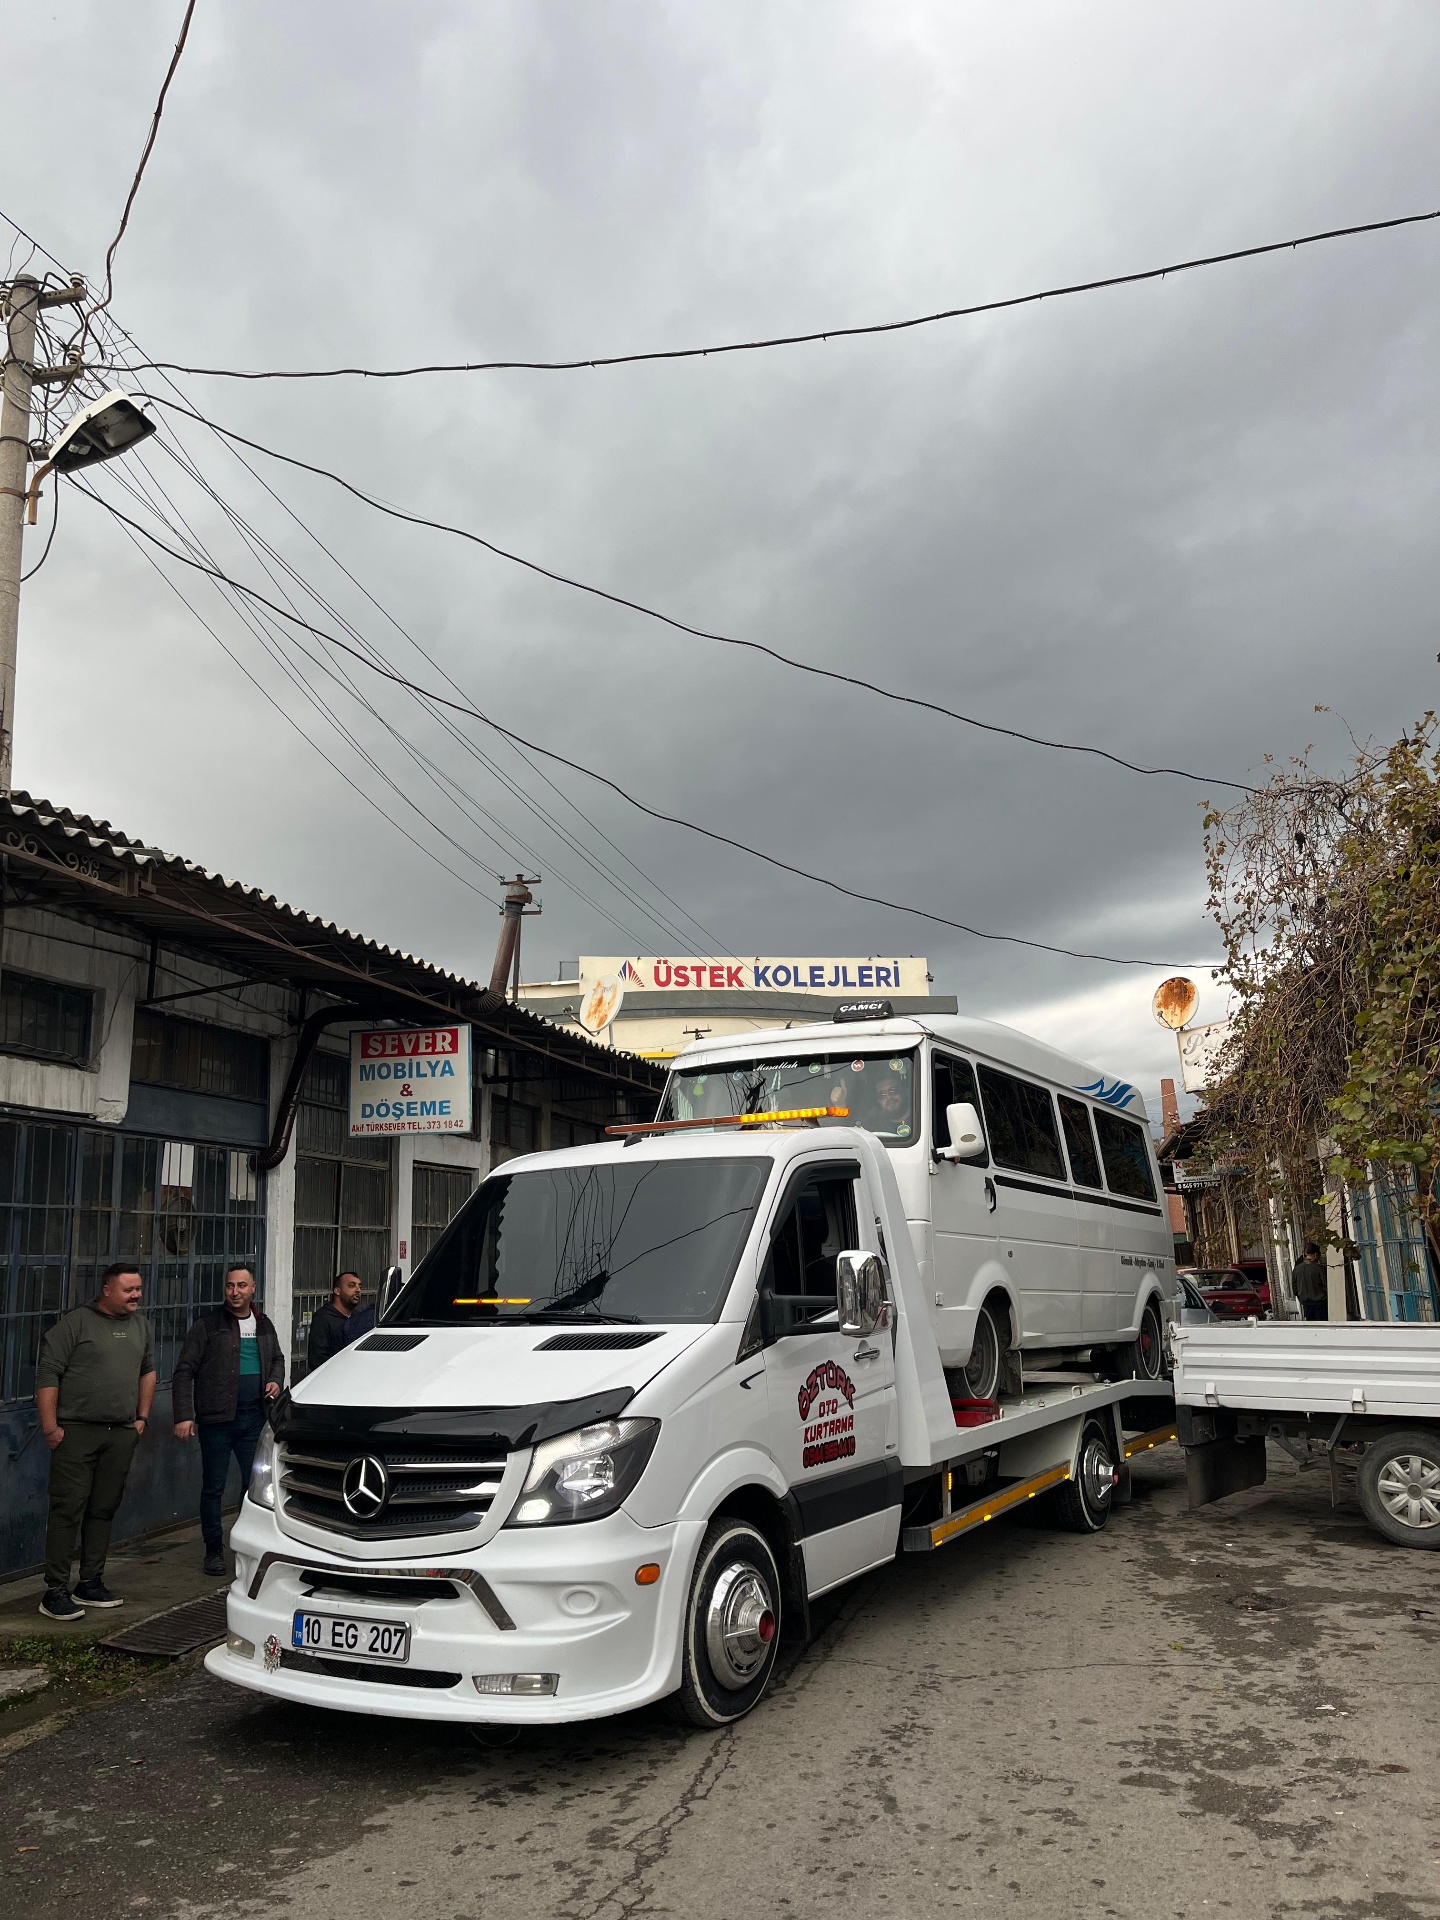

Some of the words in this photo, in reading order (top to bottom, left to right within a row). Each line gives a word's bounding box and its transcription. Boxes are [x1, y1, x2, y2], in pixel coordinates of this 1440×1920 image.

[653, 959, 745, 987] ÜSTEK
[754, 960, 900, 987] KOLEJLERİ
[367, 1031, 453, 1056] SEVER
[360, 1058, 455, 1081] MOBİLYA
[400, 1083, 413, 1097] &
[361, 1099, 451, 1121] DÖŞEME
[352, 1124, 364, 1132] Akif
[366, 1122, 406, 1132] TÜRKSEVER
[798, 1360, 856, 1421] ÖZTÜRK
[818, 1399, 838, 1418] OTO
[803, 1415, 854, 1444] KURTARMA
[295, 1631, 302, 1639] TR
[304, 1617, 321, 1644] 10
[331, 1620, 358, 1649] EG
[368, 1625, 406, 1655] 207
